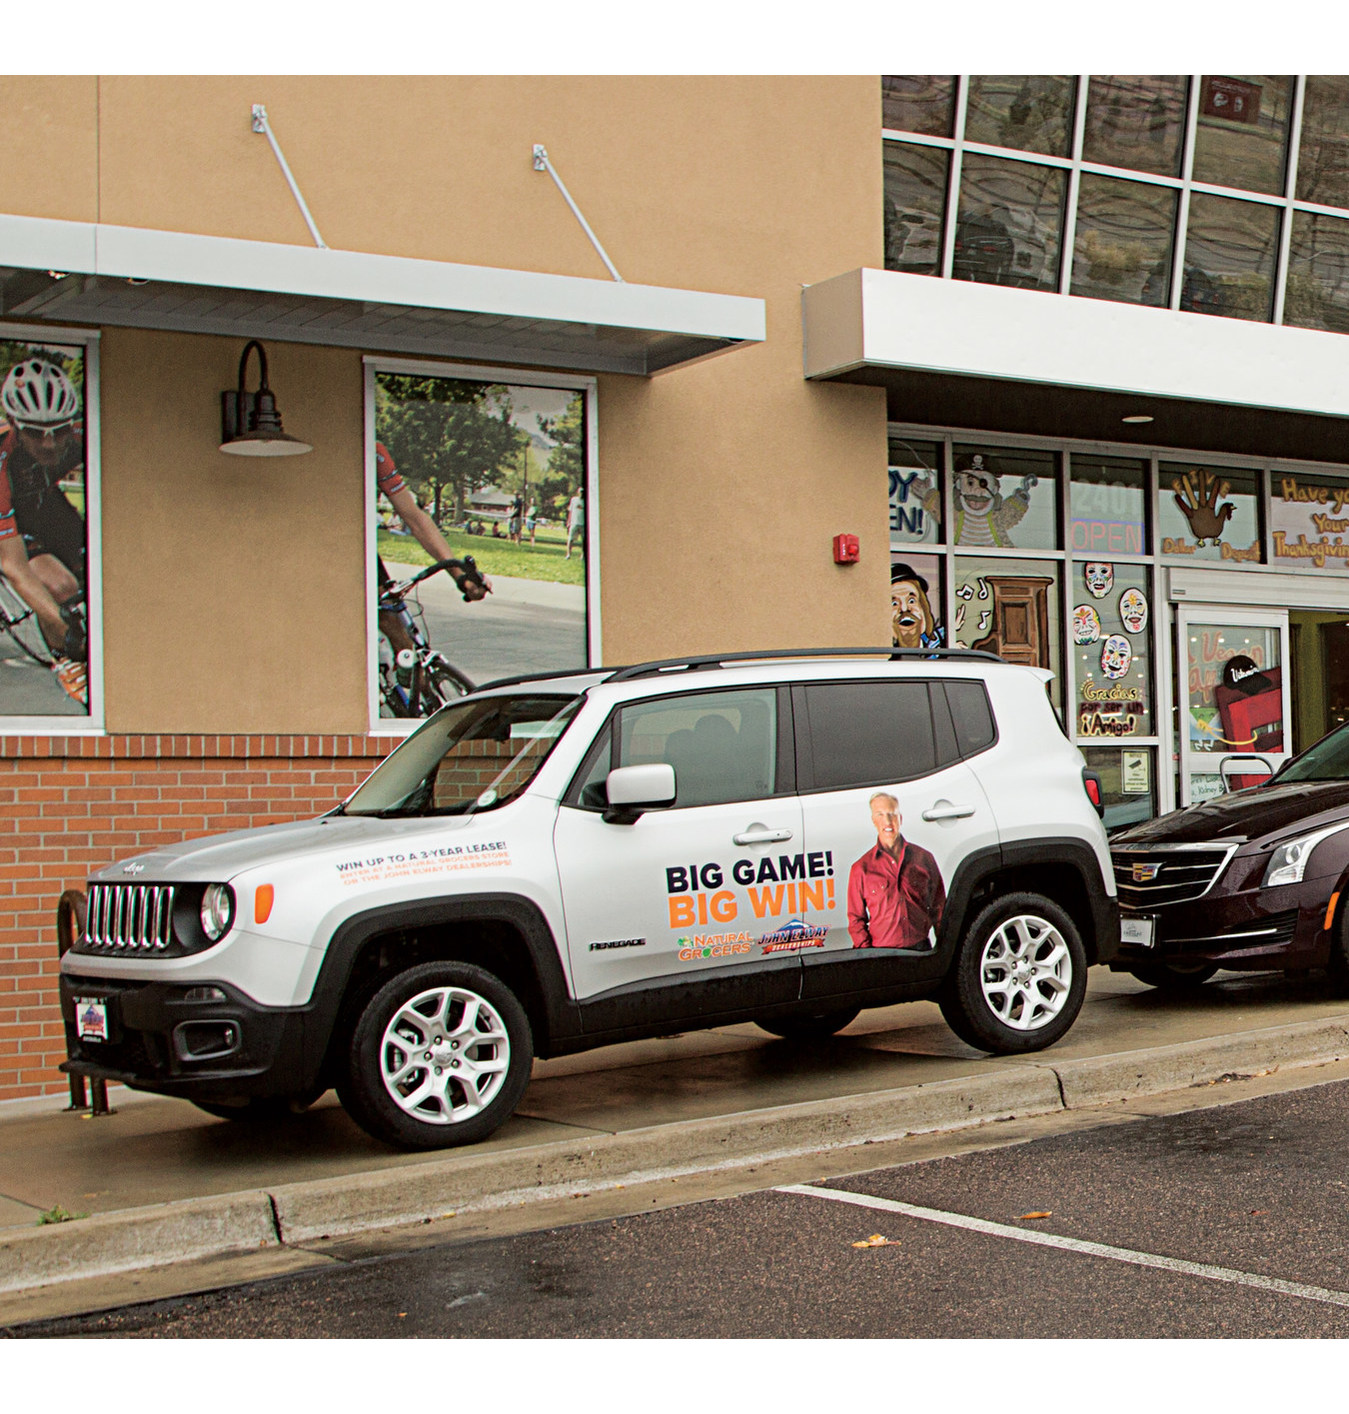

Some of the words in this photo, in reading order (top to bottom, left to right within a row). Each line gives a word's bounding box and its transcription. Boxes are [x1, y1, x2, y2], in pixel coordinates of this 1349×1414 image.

[1281, 478, 1329, 504] Have
[1071, 521, 1142, 553] OPEN
[1083, 681, 1138, 701] Gracias
[336, 861, 363, 872] WIN
[366, 857, 384, 867] UP
[387, 854, 405, 863] TO
[409, 852, 417, 861] A
[420, 846, 463, 859] 3-YEAR
[466, 841, 507, 854] LEASE!
[666, 863, 723, 893] BIG
[732, 851, 834, 885] GAME!
[668, 890, 738, 929] BIG
[747, 878, 836, 918] WIN!
[588, 938, 647, 952] RENEGADE
[694, 932, 754, 947] NATURAL
[758, 930, 791, 945] JOHN
[678, 943, 751, 961] GROCERS
